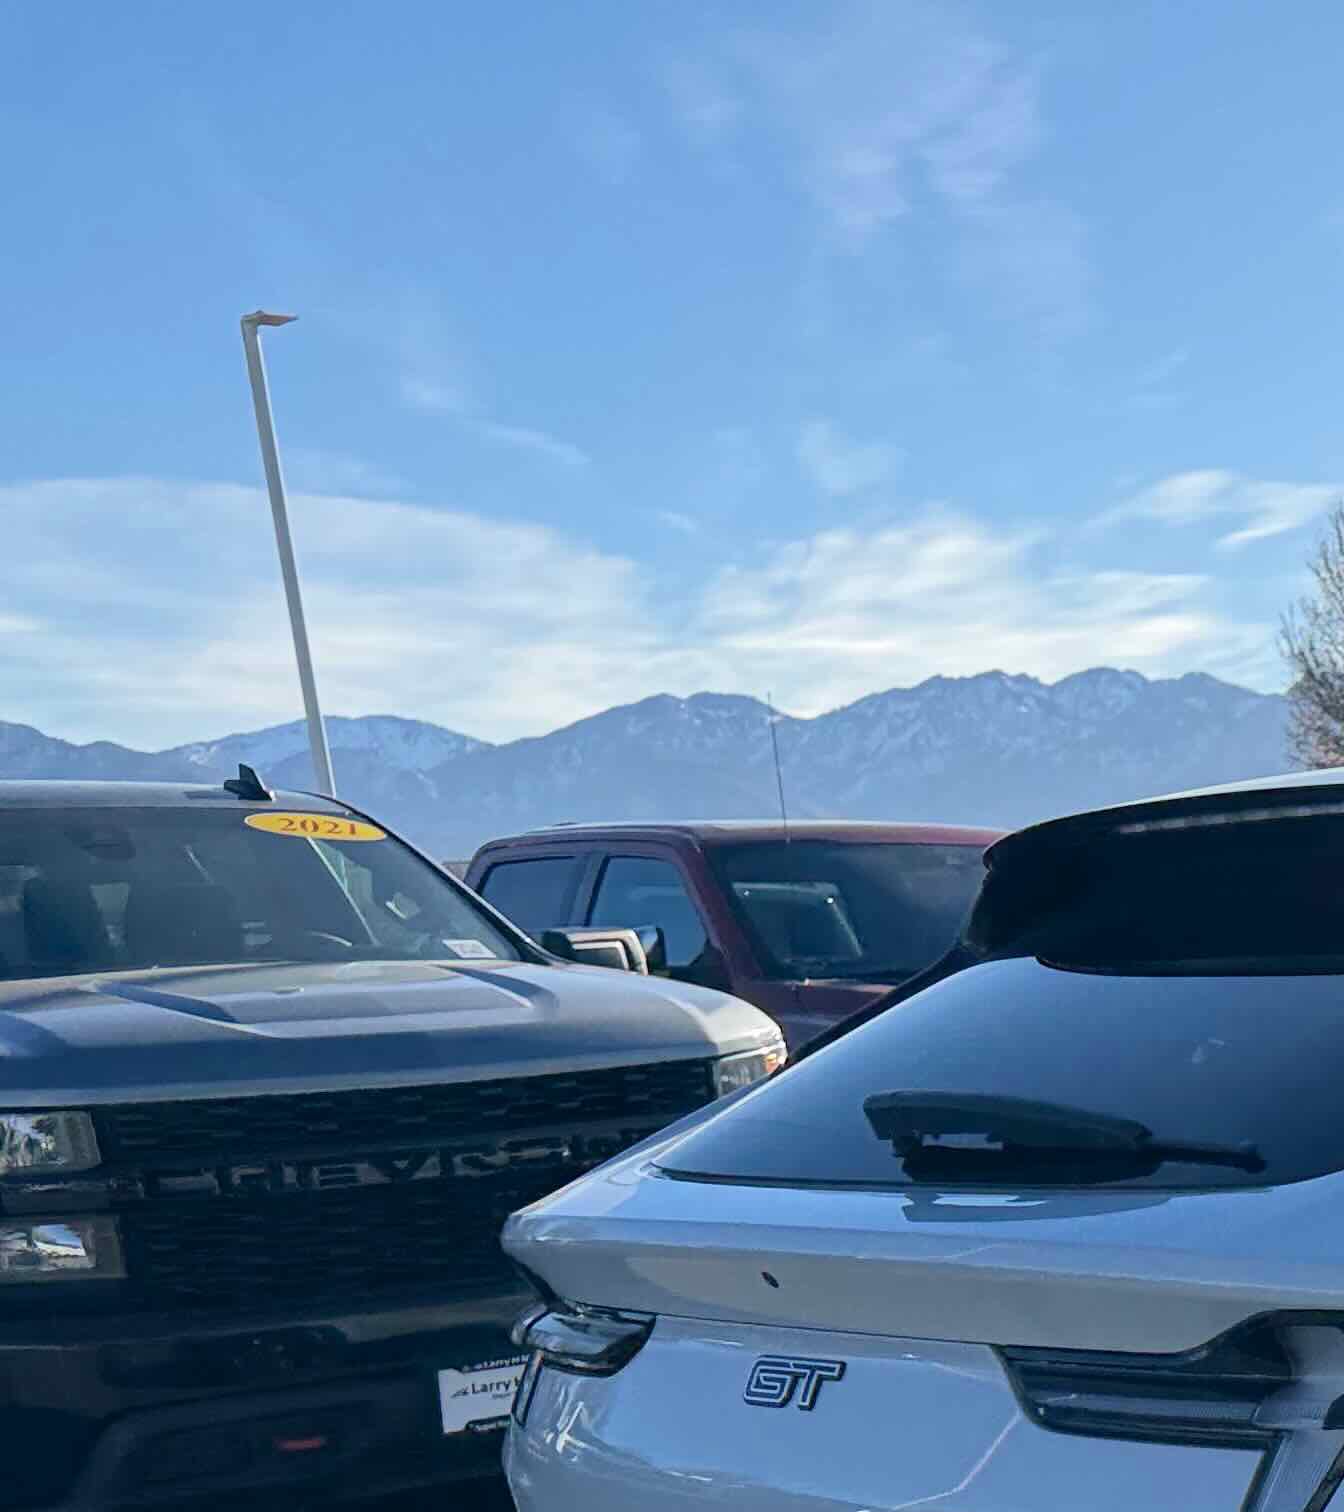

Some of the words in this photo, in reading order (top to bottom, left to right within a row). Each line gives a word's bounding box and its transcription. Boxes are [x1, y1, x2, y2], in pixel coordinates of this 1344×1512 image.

[278, 818, 356, 836] 2021
[471, 1379, 512, 1395] Larry
[744, 1354, 847, 1411] GT
